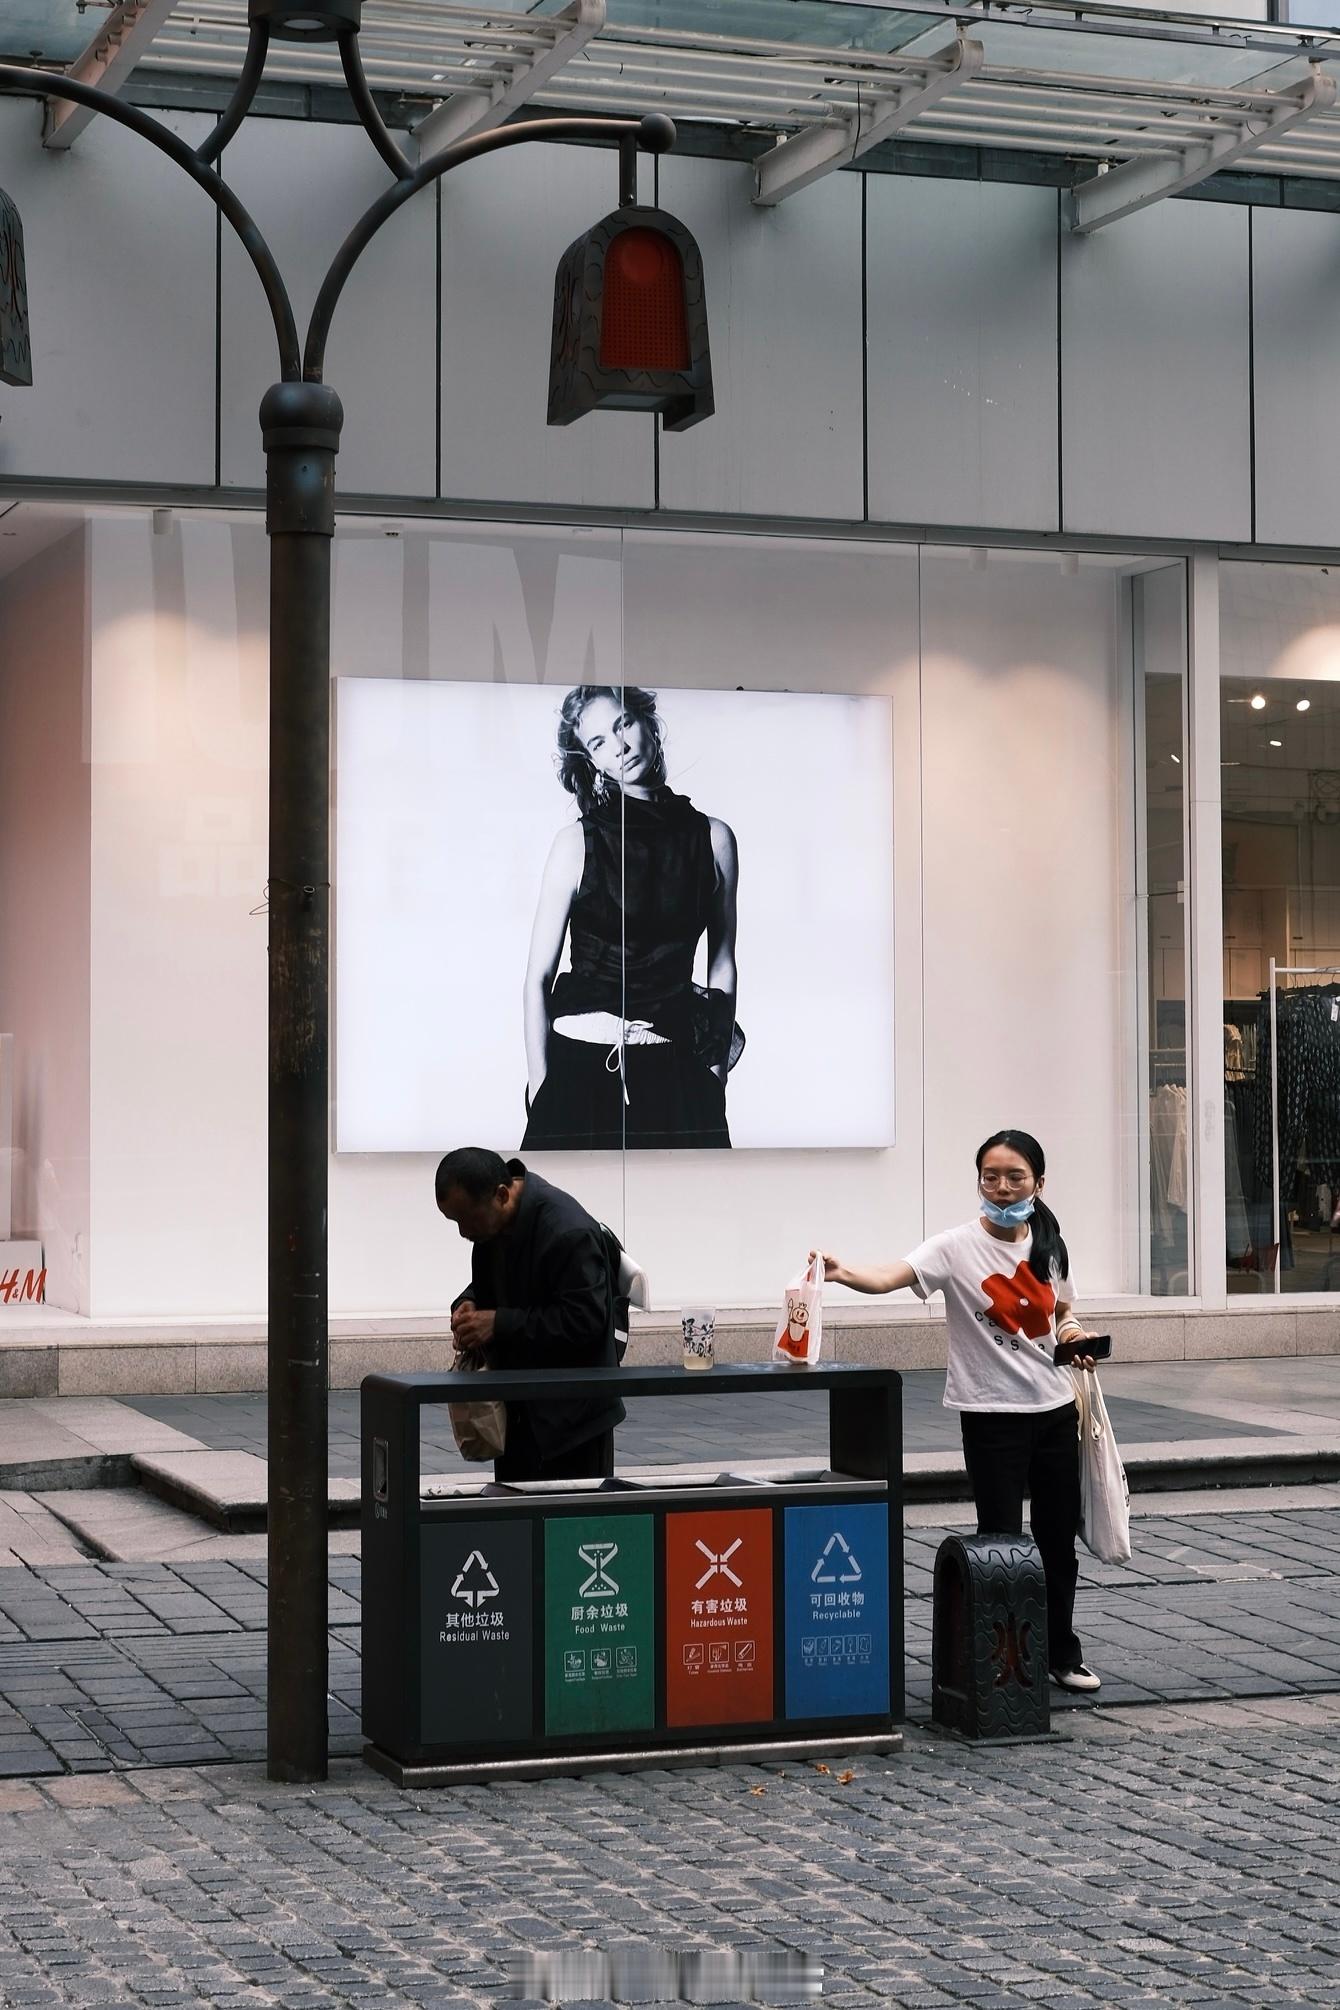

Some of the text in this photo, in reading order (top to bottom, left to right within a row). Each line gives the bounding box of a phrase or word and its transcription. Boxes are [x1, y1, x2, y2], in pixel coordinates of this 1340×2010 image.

[0, 1268, 48, 1304] H&M
[691, 1597, 748, 1615] 有害垃圾
[809, 1591, 865, 1608] 可回收物
[445, 1611, 504, 1629] 其他垃圾
[571, 1603, 629, 1621] 厨余垃圾
[812, 1609, 861, 1621] Recyclable
[575, 1622, 626, 1635] Food Waste
[690, 1616, 748, 1629] Hazardous Waste
[439, 1629, 510, 1642] Residual Waste
